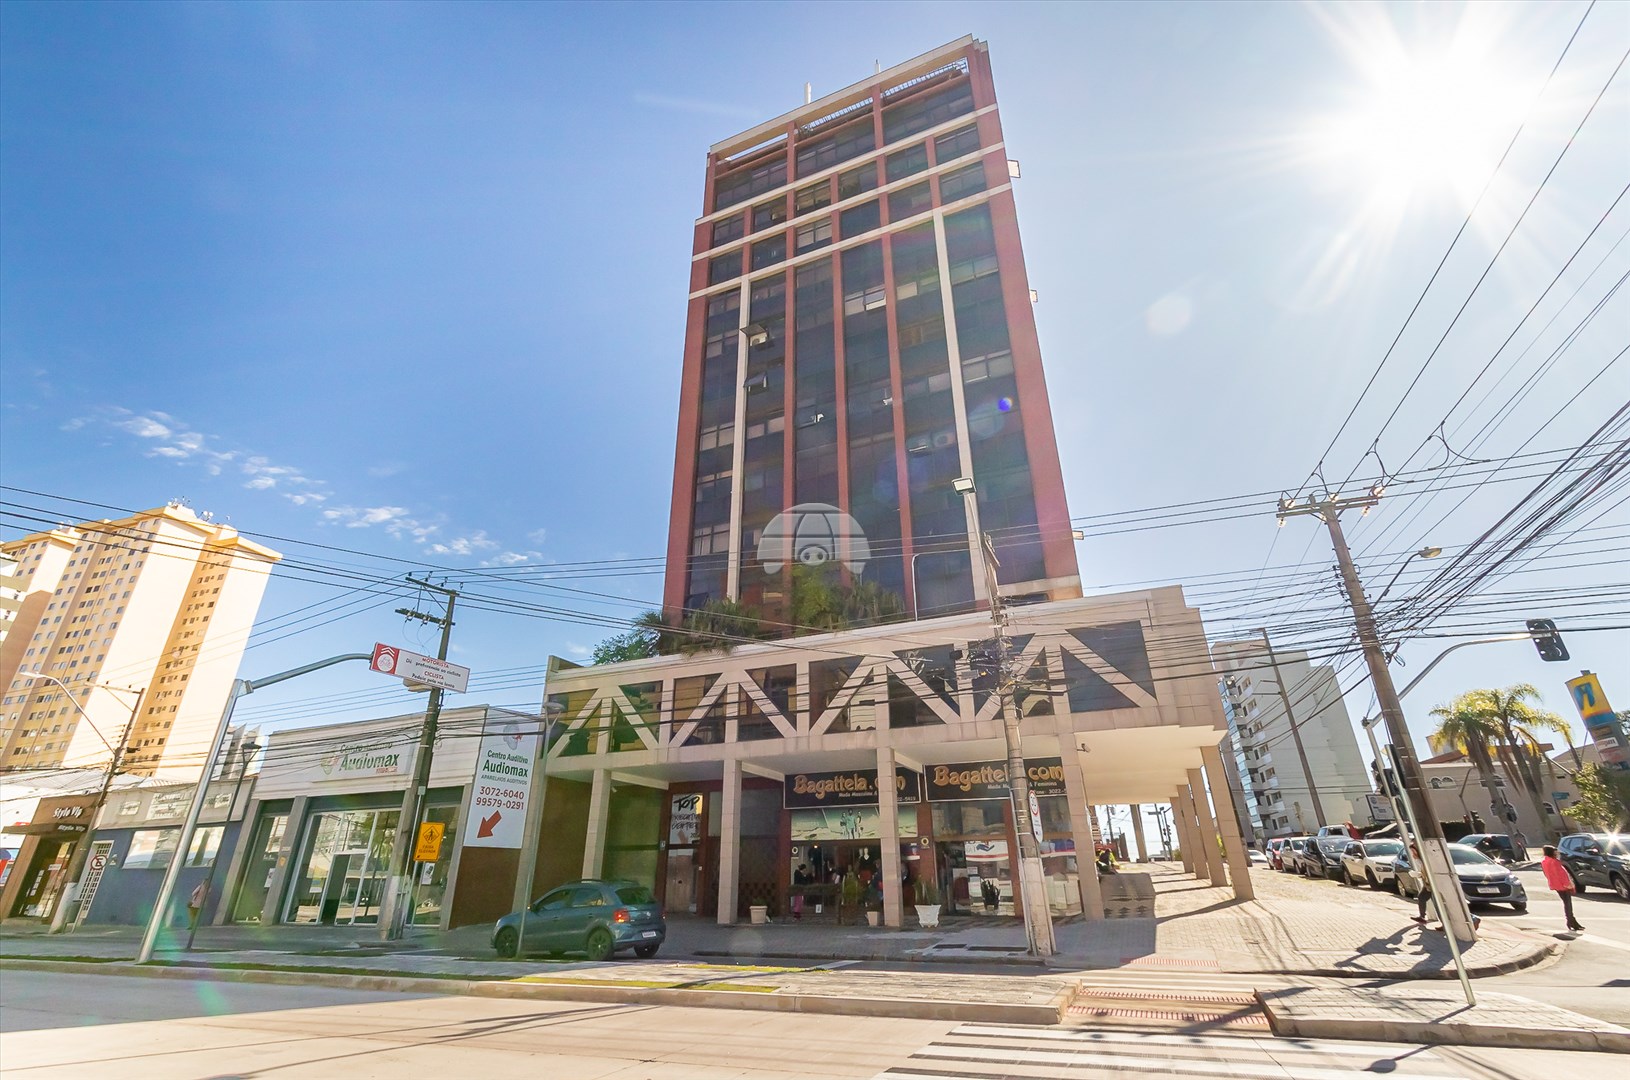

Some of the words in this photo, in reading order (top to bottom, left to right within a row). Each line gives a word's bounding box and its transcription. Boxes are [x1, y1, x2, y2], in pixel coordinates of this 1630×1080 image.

[422, 657, 449, 669] MOTORISTA
[424, 670, 444, 680] CICLISTA
[340, 753, 400, 771] Audiomax
[487, 749, 506, 760] Centro
[506, 753, 529, 764] Auditivo
[482, 759, 529, 778] Audiomax
[480, 774, 506, 783] APARELHOS
[479, 786, 525, 800] 3072-6040
[476, 797, 525, 810] 99579-0291
[673, 794, 700, 811] TOP
[52, 807, 71, 819] Style
[71, 806, 83, 818] Vip
